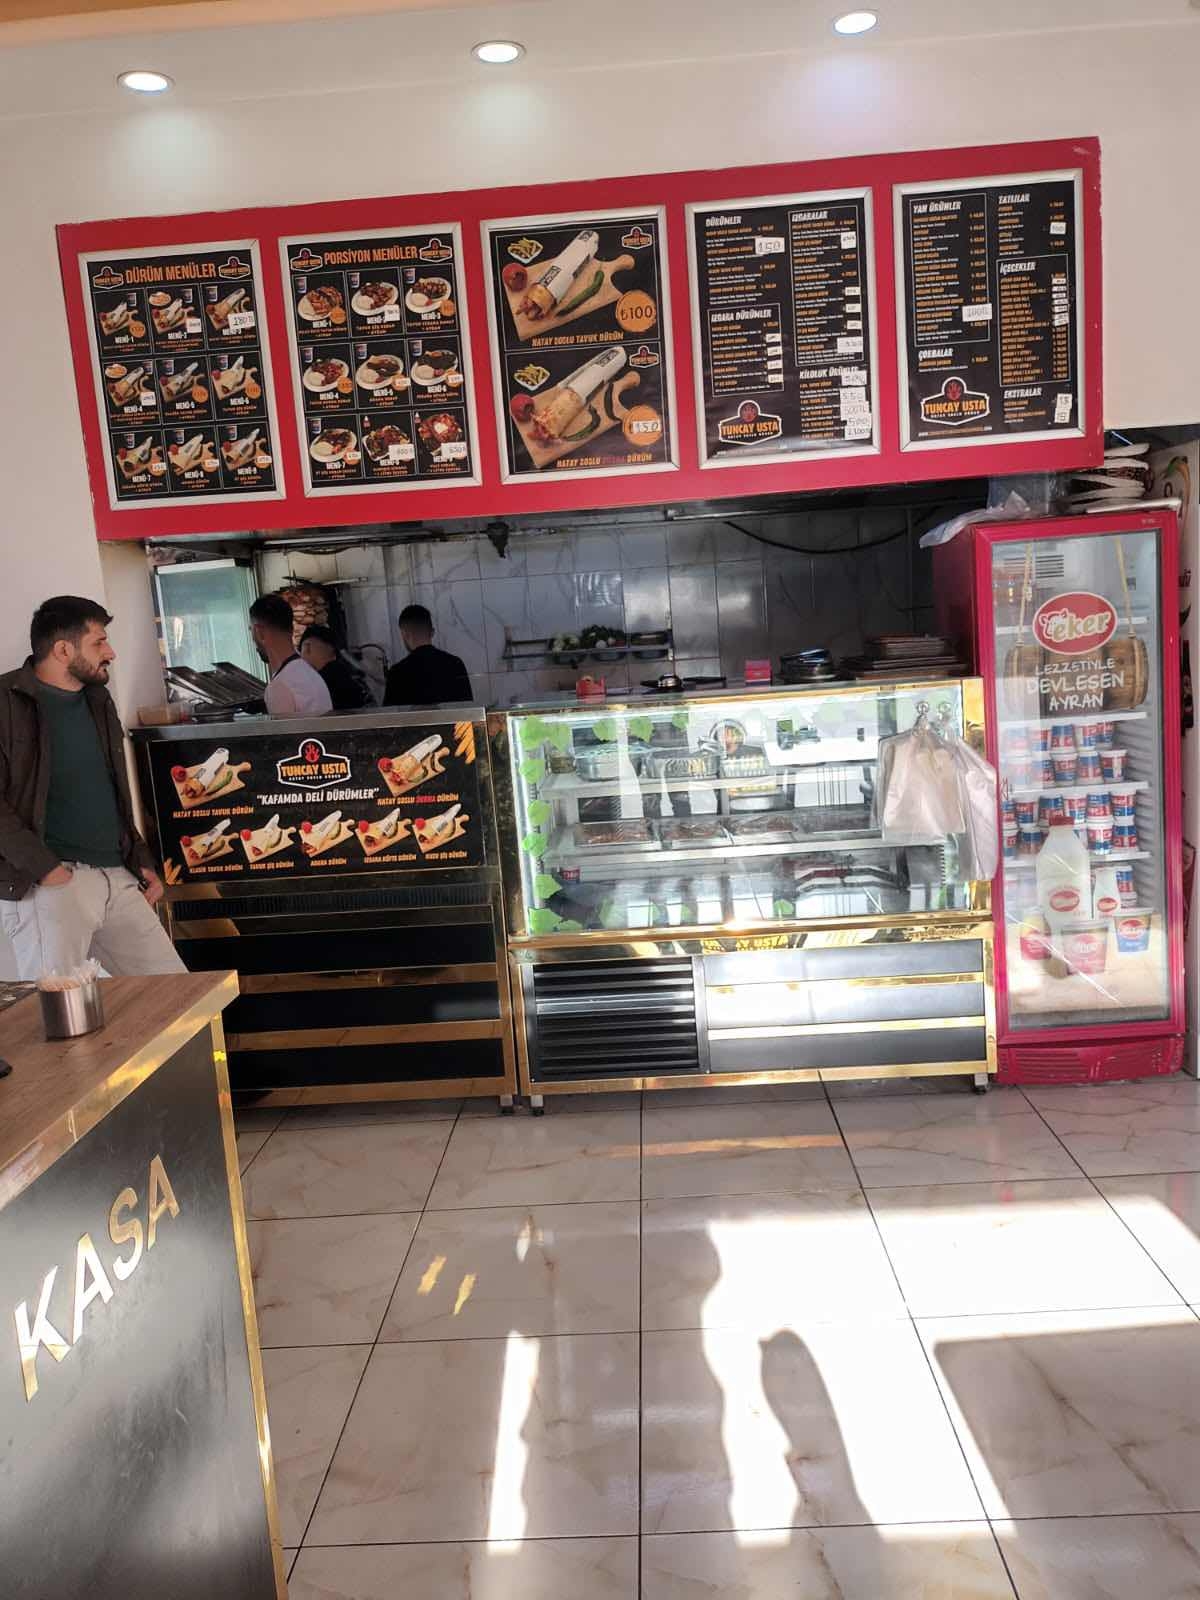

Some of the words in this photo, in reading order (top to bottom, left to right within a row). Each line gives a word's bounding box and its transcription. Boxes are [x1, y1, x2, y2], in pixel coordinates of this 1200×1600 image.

[324, 249, 370, 264] PORSİYON
[372, 244, 418, 262] MENÜLER
[126, 266, 164, 284] DÜRÜM
[166, 263, 217, 280] MENÜLER
[925, 402, 960, 414] TUNCAY
[962, 400, 986, 410] USTA
[722, 423, 755, 436] TUNCAY
[757, 421, 779, 432] USTA
[1035, 658, 1116, 676] LEZZETİYLE
[1048, 693, 1104, 712] AYRAN
[281, 764, 319, 776] TUNCAY
[322, 762, 347, 774] USTA
[305, 790, 324, 803] DELİ
[14, 1152, 181, 1404] KASA
